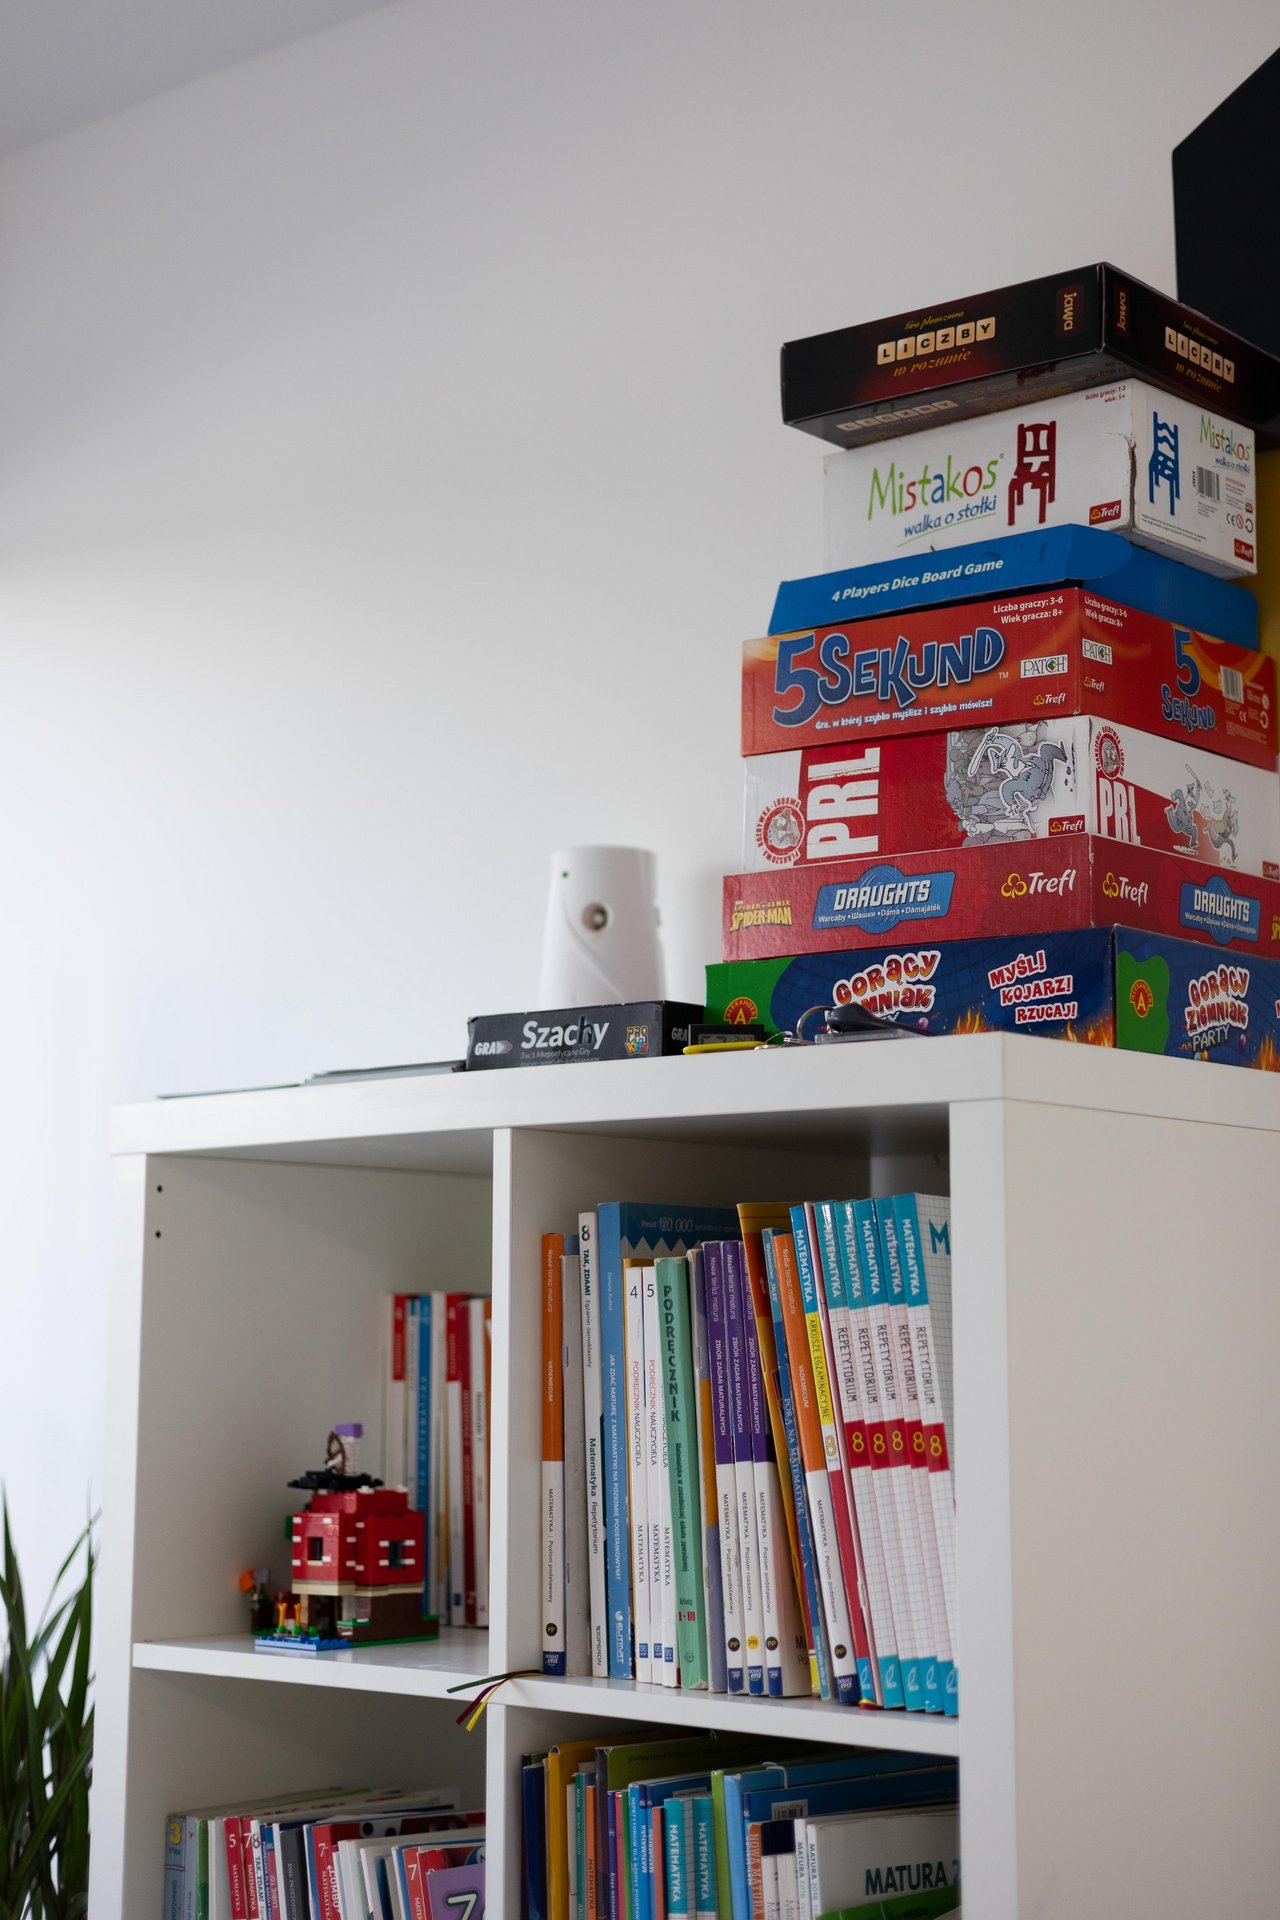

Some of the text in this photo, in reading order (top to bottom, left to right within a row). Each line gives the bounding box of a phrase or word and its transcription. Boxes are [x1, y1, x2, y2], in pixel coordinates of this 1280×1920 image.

[1063, 292, 1077, 331] jawa
[1117, 291, 1126, 332] jawa
[881, 321, 993, 361] LICZBY
[1167, 331, 1234, 379] LICZBY
[911, 350, 971, 374] rozumie
[1187, 367, 1222, 393] rozumie
[1200, 415, 1250, 461] Mistakos
[868, 455, 998, 521] Mistakos
[904, 495, 997, 537] walka o stołki
[1100, 505, 1120, 518] Trefl
[832, 560, 1004, 601] 4 Players Dice Board Game
[993, 596, 1064, 614] Liczba graczy: 3-6
[1001, 608, 1064, 624] Wiek gracza: 8+
[1084, 596, 1128, 618] Liczba graczy: 3-6
[1085, 608, 1124, 628] Wiek gracza: 8+
[1023, 655, 1068, 676] PATCH
[1084, 640, 1112, 663] PATCH
[1173, 627, 1201, 697] 5
[773, 631, 822, 727] 5
[817, 627, 1005, 708] SEKUND
[832, 698, 993, 727] w której szybko myślisz i szybko mówisz!
[1045, 692, 1066, 706] Trefl
[1160, 684, 1216, 733] SEKUND
[806, 747, 880, 859] PRL
[1098, 777, 1141, 845] PRL
[1062, 820, 1083, 832] Trefl
[833, 879, 931, 911] DRAUGHTS
[1028, 869, 1077, 896] Trefl
[1119, 877, 1148, 904] Trefl
[728, 907, 793, 932] SPIDER-MAN
[818, 913, 846, 923] Warcaby
[1194, 889, 1250, 922] DRAUGHTS
[989, 951, 1046, 987] MYŚL!
[726, 999, 756, 1018] ALEXANDER
[1001, 976, 1072, 1005] KOJARZ!
[1016, 1003, 1077, 1024] RZUCAJ!
[520, 1016, 610, 1050] Szachy
[626, 1026, 648, 1038] PRO
[1193, 1024, 1230, 1051] PARTY
[584, 1269, 592, 1296] ZDAM!
[796, 1229, 812, 1302] MATEMATYKA
[630, 1286, 639, 1299] 4
[646, 1284, 654, 1298] 5
[711, 1277, 719, 1295] teraz
[728, 1275, 736, 1293] teraz
[785, 1268, 796, 1314] teraz matura
[729, 1295, 737, 1320] matura
[663, 1285, 680, 1422] PODRĘCZNIK
[809, 1319, 821, 1353] ARKUSZE
[824, 1226, 864, 1453] MATEMATYKA REPETYTORIUM 8
[844, 1224, 885, 1454] MATEMATYKA REPETYTORIUM 8
[863, 1220, 903, 1451] MATEMATYKA REPETYTORIUM 8
[884, 1219, 925, 1453] MATEMATYKA REPETYTORIUM 8
[902, 1219, 942, 1456] MATEMATYKA REPETYTORIUM 8
[715, 1340, 726, 1436] ZBIÓR ZADAŃ MATURALNYCH
[734, 1359, 742, 1382] ZADAŃ
[749, 1337, 760, 1433] ZBIÓR ZADAŃ MATURALNYCH
[799, 1364, 809, 1408] VADEMECUM
[813, 1356, 830, 1419] EGZAMINACYJNE
[735, 1383, 743, 1433] MATURALNYCH
[611, 1425, 619, 1469] MATEMATYKI
[825, 1434, 837, 1456] 8
[613, 1471, 619, 1481] NA
[588, 1438, 599, 1554] Matematyka Repetytorium
[722, 1494, 731, 1540] MATEMATYKA
[727, 1572, 735, 1615] podstawowy
[741, 1492, 749, 1539] MATEMATYKA
[745, 1572, 753, 1612] rozszerzony
[759, 1492, 772, 1614] MATEMATYKA Poziom podstawowy
[817, 1500, 837, 1623] MATEMATYKA Poziom podstawowy
[169, 1823, 181, 1845] 3
[228, 1834, 236, 1848] 5
[750, 1834, 760, 1865] NOWA
[408, 1864, 418, 1880] 7
[670, 1825, 681, 1902] MATEMATYKA
[698, 1822, 709, 1900] MATEMATYKA
[797, 1842, 805, 1878] MATURA
[809, 1843, 818, 1880] MATURA
[232, 1864, 241, 1911] MATEMATYKA
[247, 1864, 256, 1911] MATEMATYKA
[330, 1870, 339, 1908] COMBO
[751, 1868, 763, 1914] MATURA
[865, 1861, 948, 1896] MATURA
